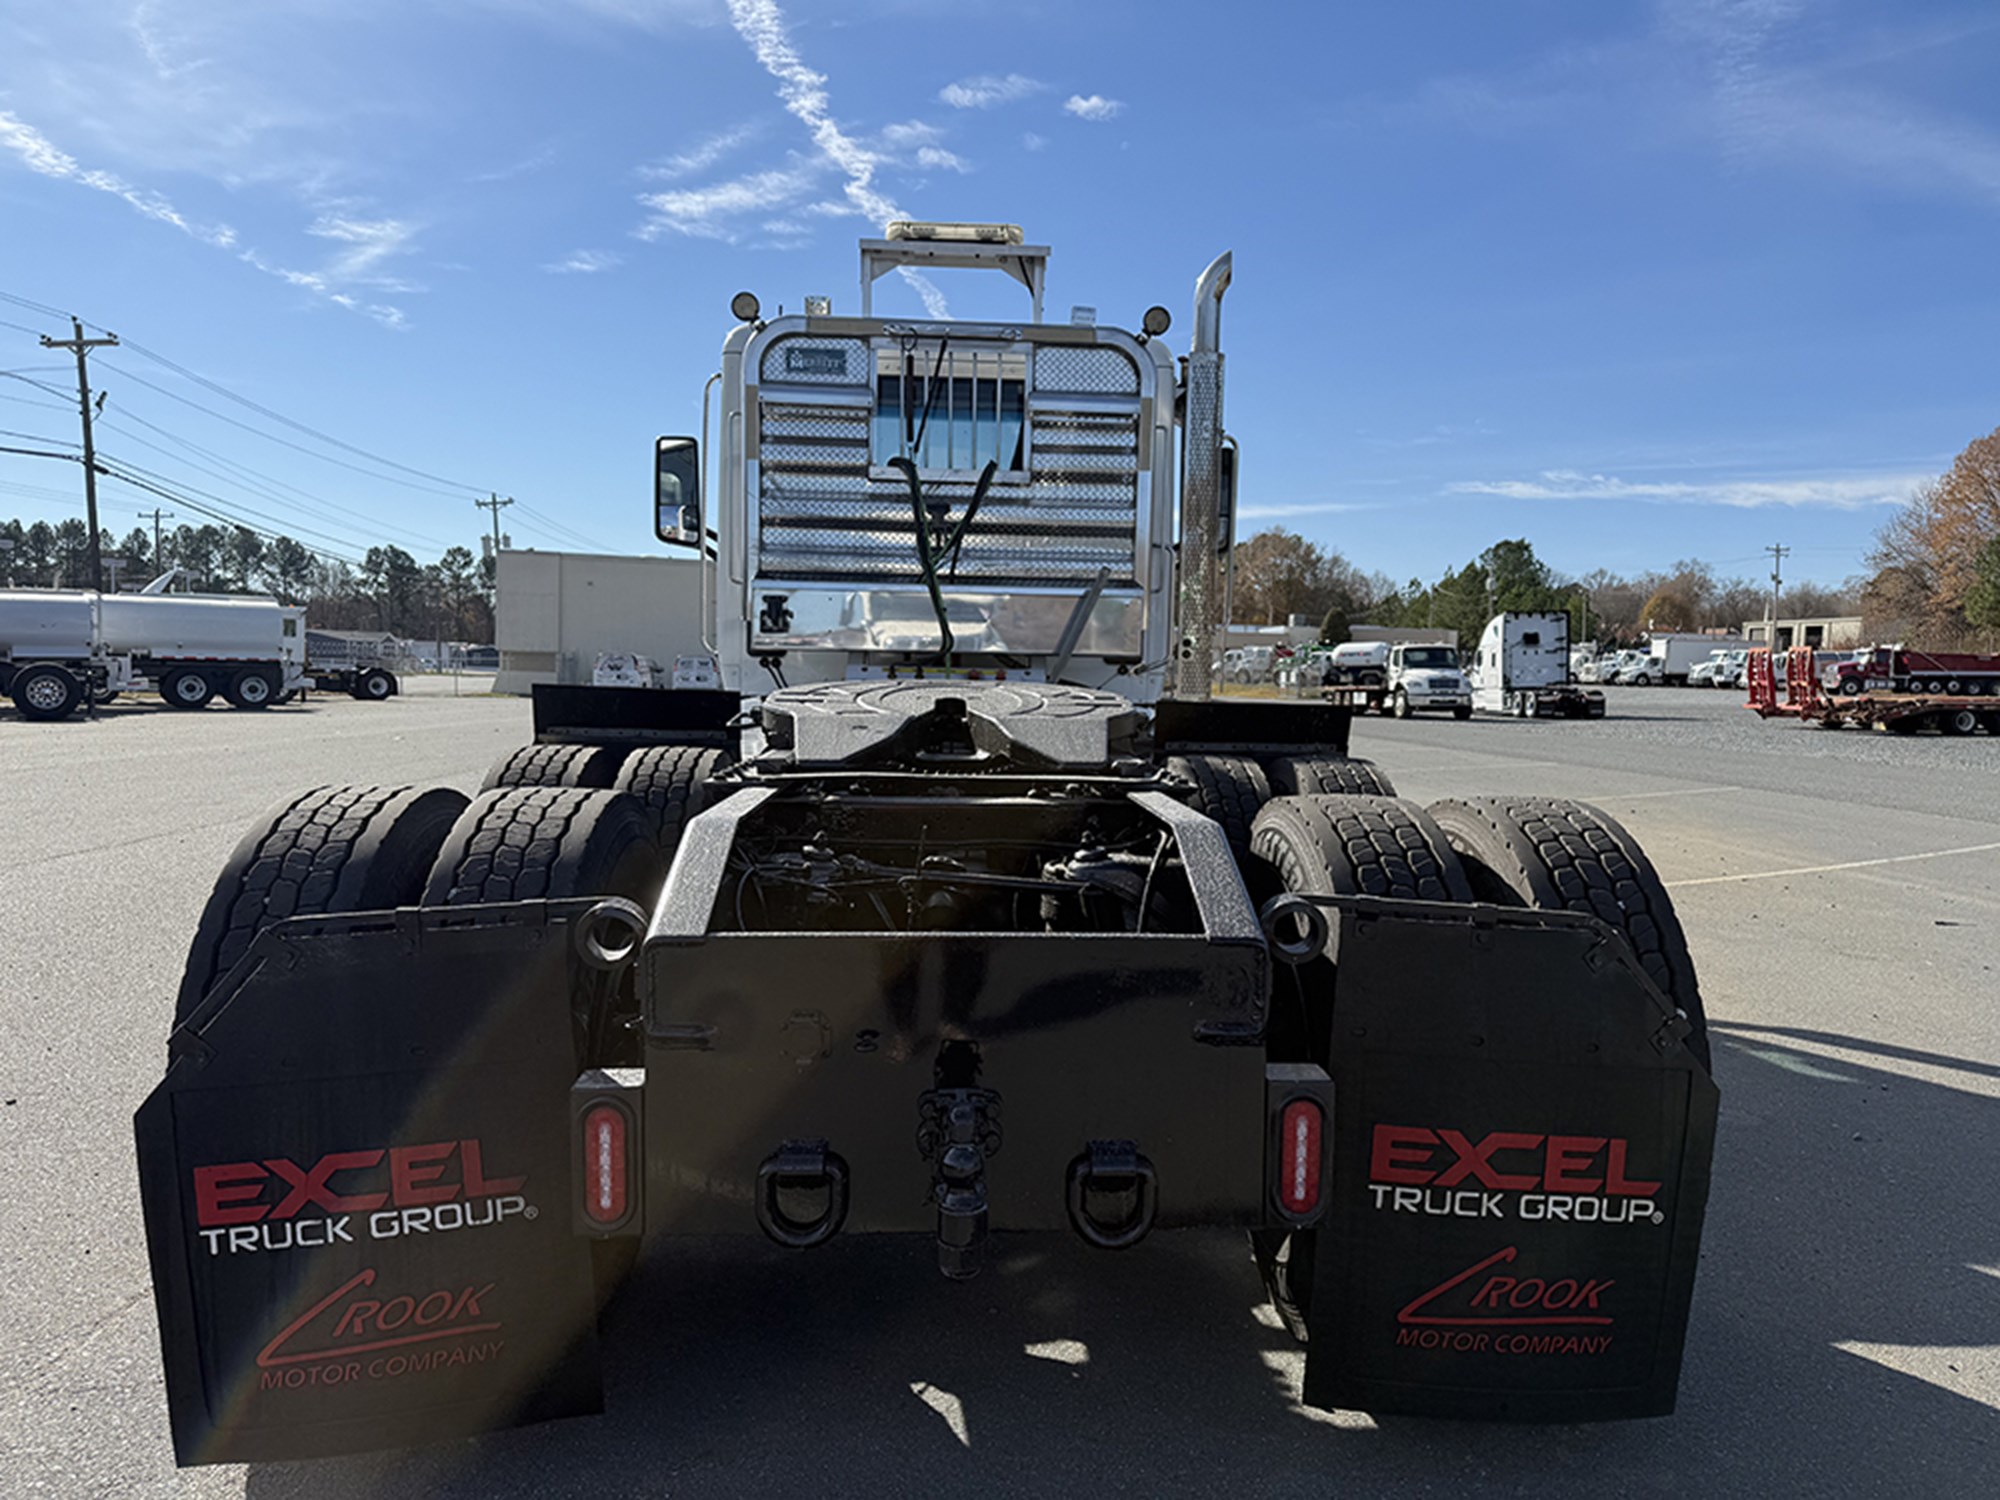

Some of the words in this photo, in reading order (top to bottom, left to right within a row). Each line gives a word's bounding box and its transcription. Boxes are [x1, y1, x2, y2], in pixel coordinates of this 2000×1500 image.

[1370, 1124, 1662, 1196] EXCEL
[193, 1139, 528, 1226] EXCEL
[1368, 1184, 1504, 1218] TRUCK
[199, 1215, 353, 1255] TRUCK
[1396, 1327, 1490, 1351] MOTOR
[1494, 1334, 1613, 1354] COMPANY
[260, 1363, 361, 1390] MOTOR
[367, 1341, 504, 1379] COMPANY
